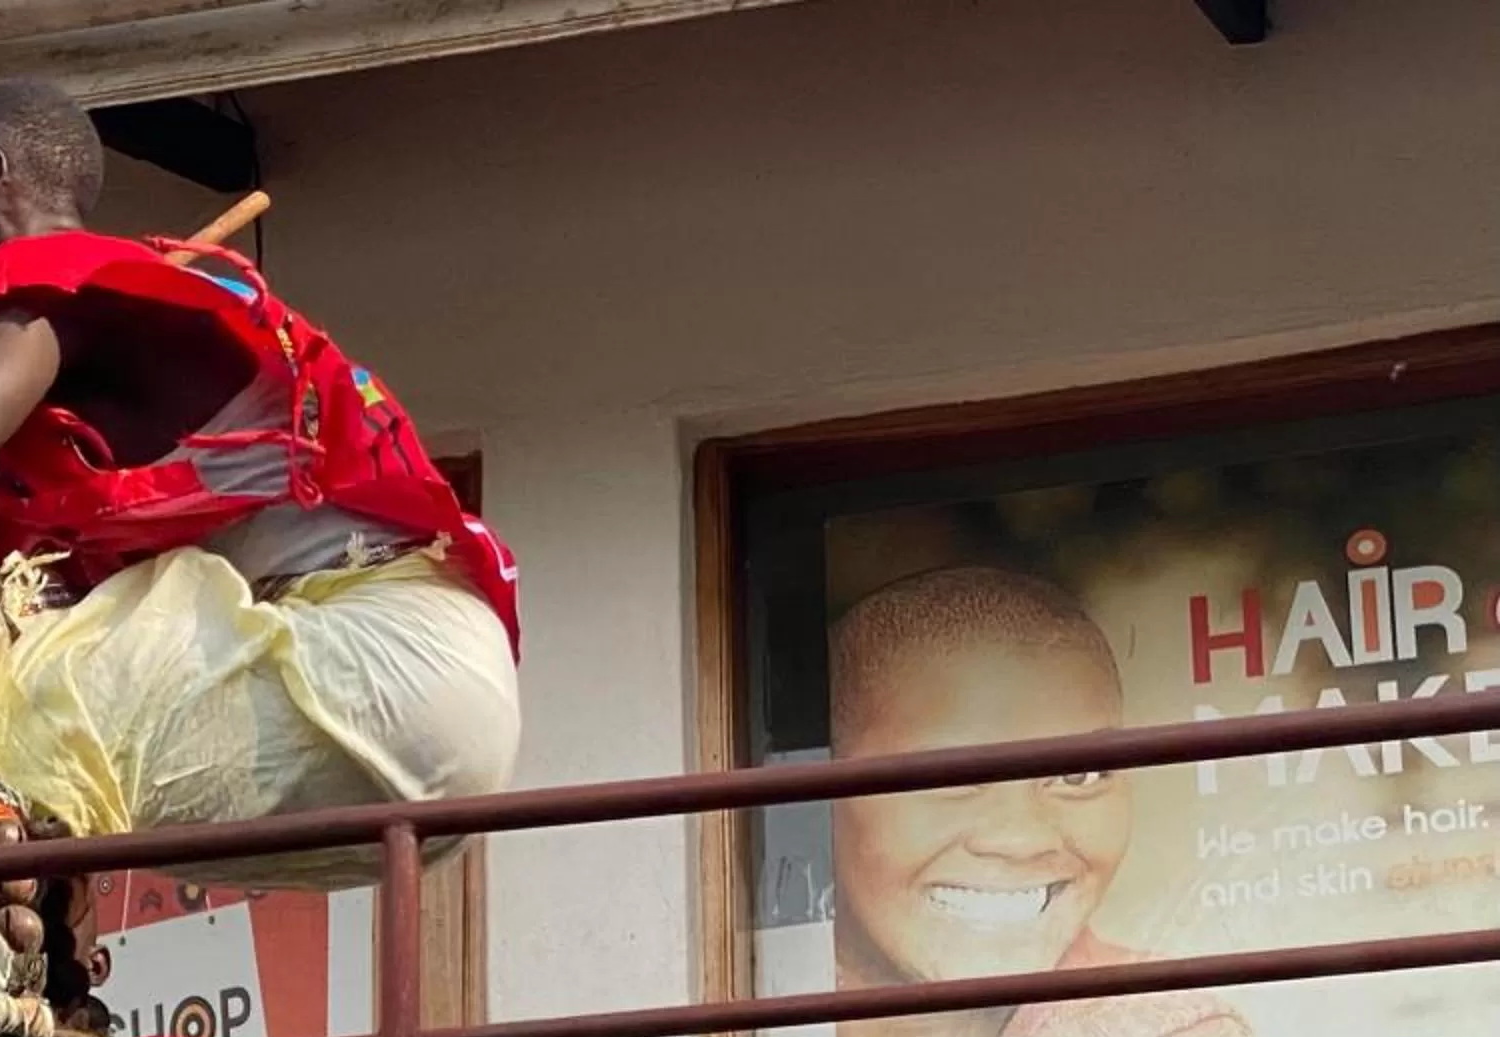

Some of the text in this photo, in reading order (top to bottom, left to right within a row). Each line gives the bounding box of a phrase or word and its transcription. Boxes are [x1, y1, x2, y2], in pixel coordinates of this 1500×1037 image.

[1196, 824, 1256, 859] We
[1273, 811, 1388, 851] make
[1200, 868, 1280, 908] and
[1297, 862, 1374, 898] skin
